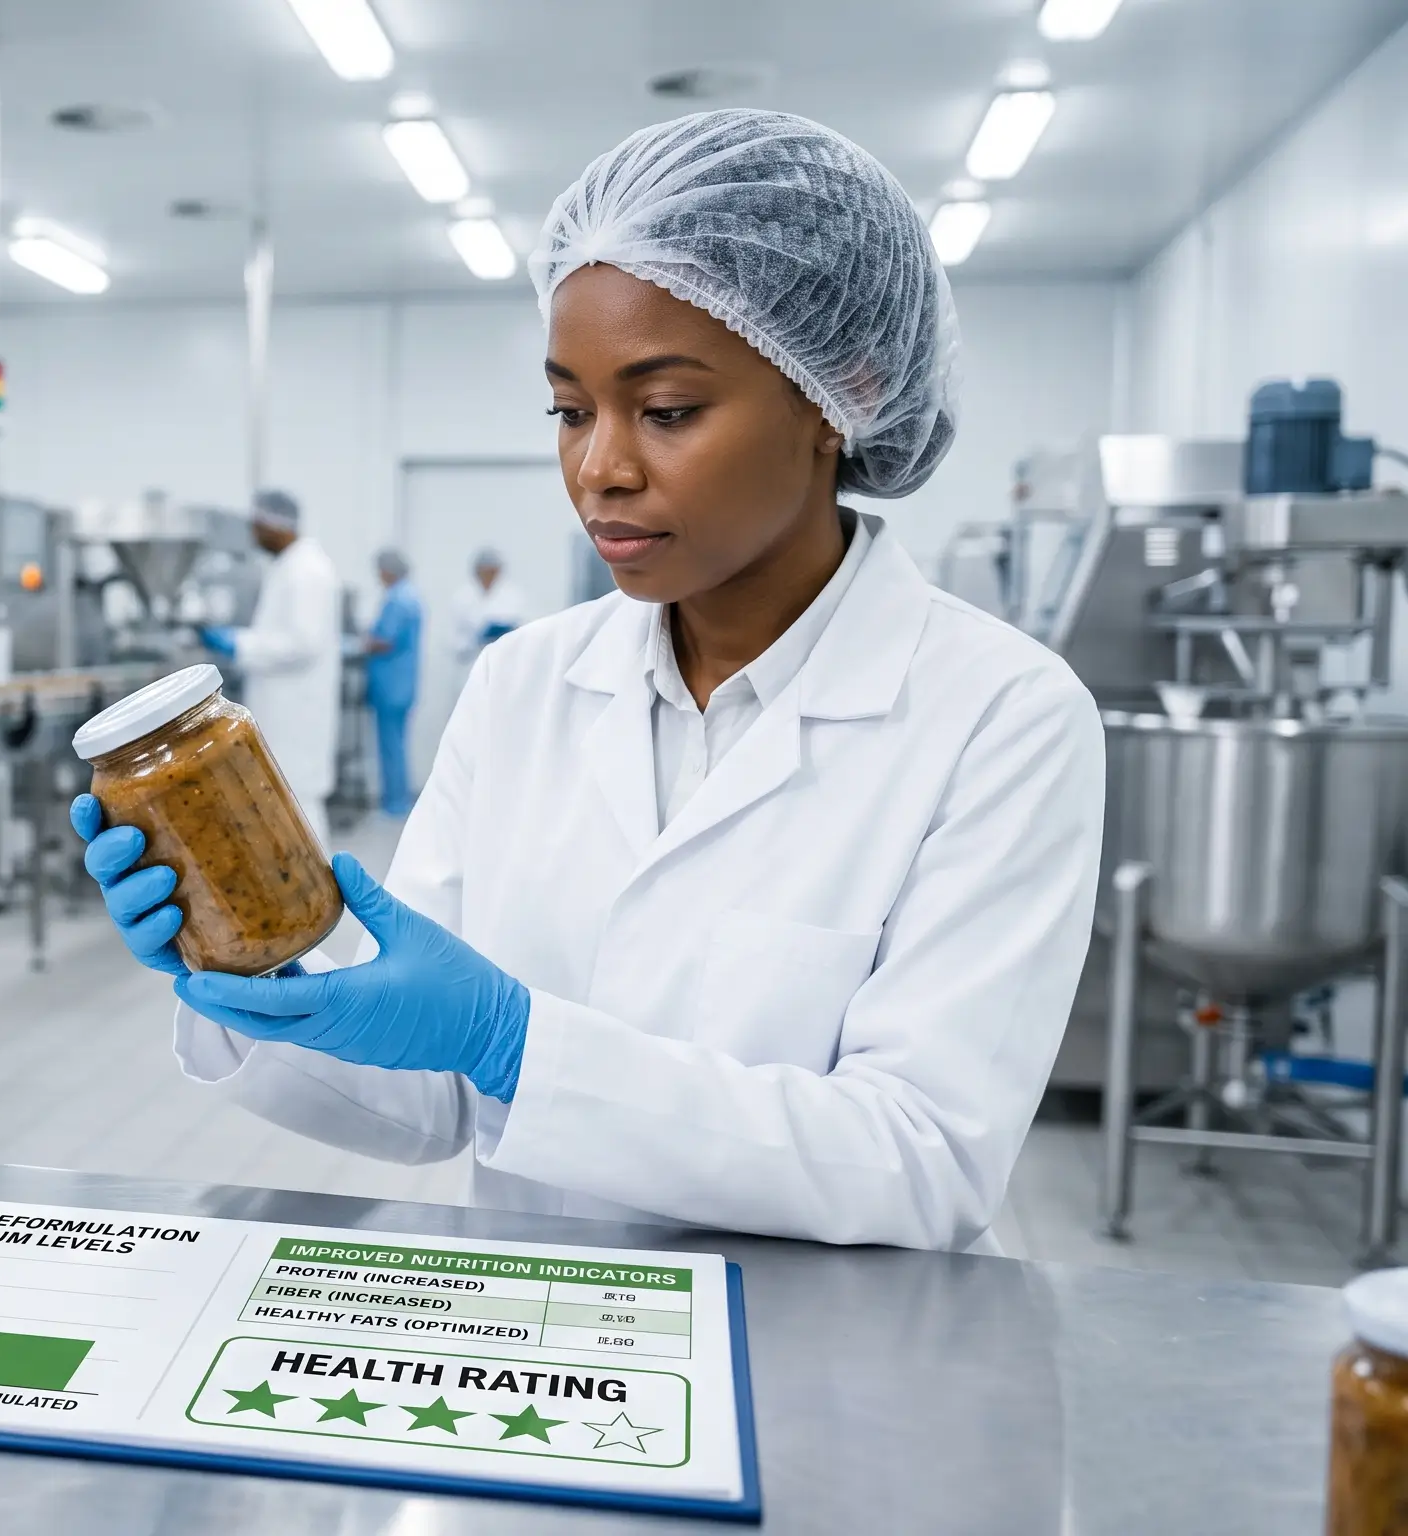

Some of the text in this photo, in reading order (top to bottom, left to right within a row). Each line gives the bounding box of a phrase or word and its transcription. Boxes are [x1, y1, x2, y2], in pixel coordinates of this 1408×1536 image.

[36, 1234, 136, 1254] LEVELS
[275, 1265, 485, 1293] PROTEIN (INCREASED)
[289, 1245, 676, 1285] IMPROVED NUTRITION INDICATORS
[265, 1285, 452, 1312] FIBER (INCREASED)
[254, 1306, 529, 1341] HEALTHY FATS (OPTIMIZED)
[270, 1350, 628, 1403] HEALTH RATING
